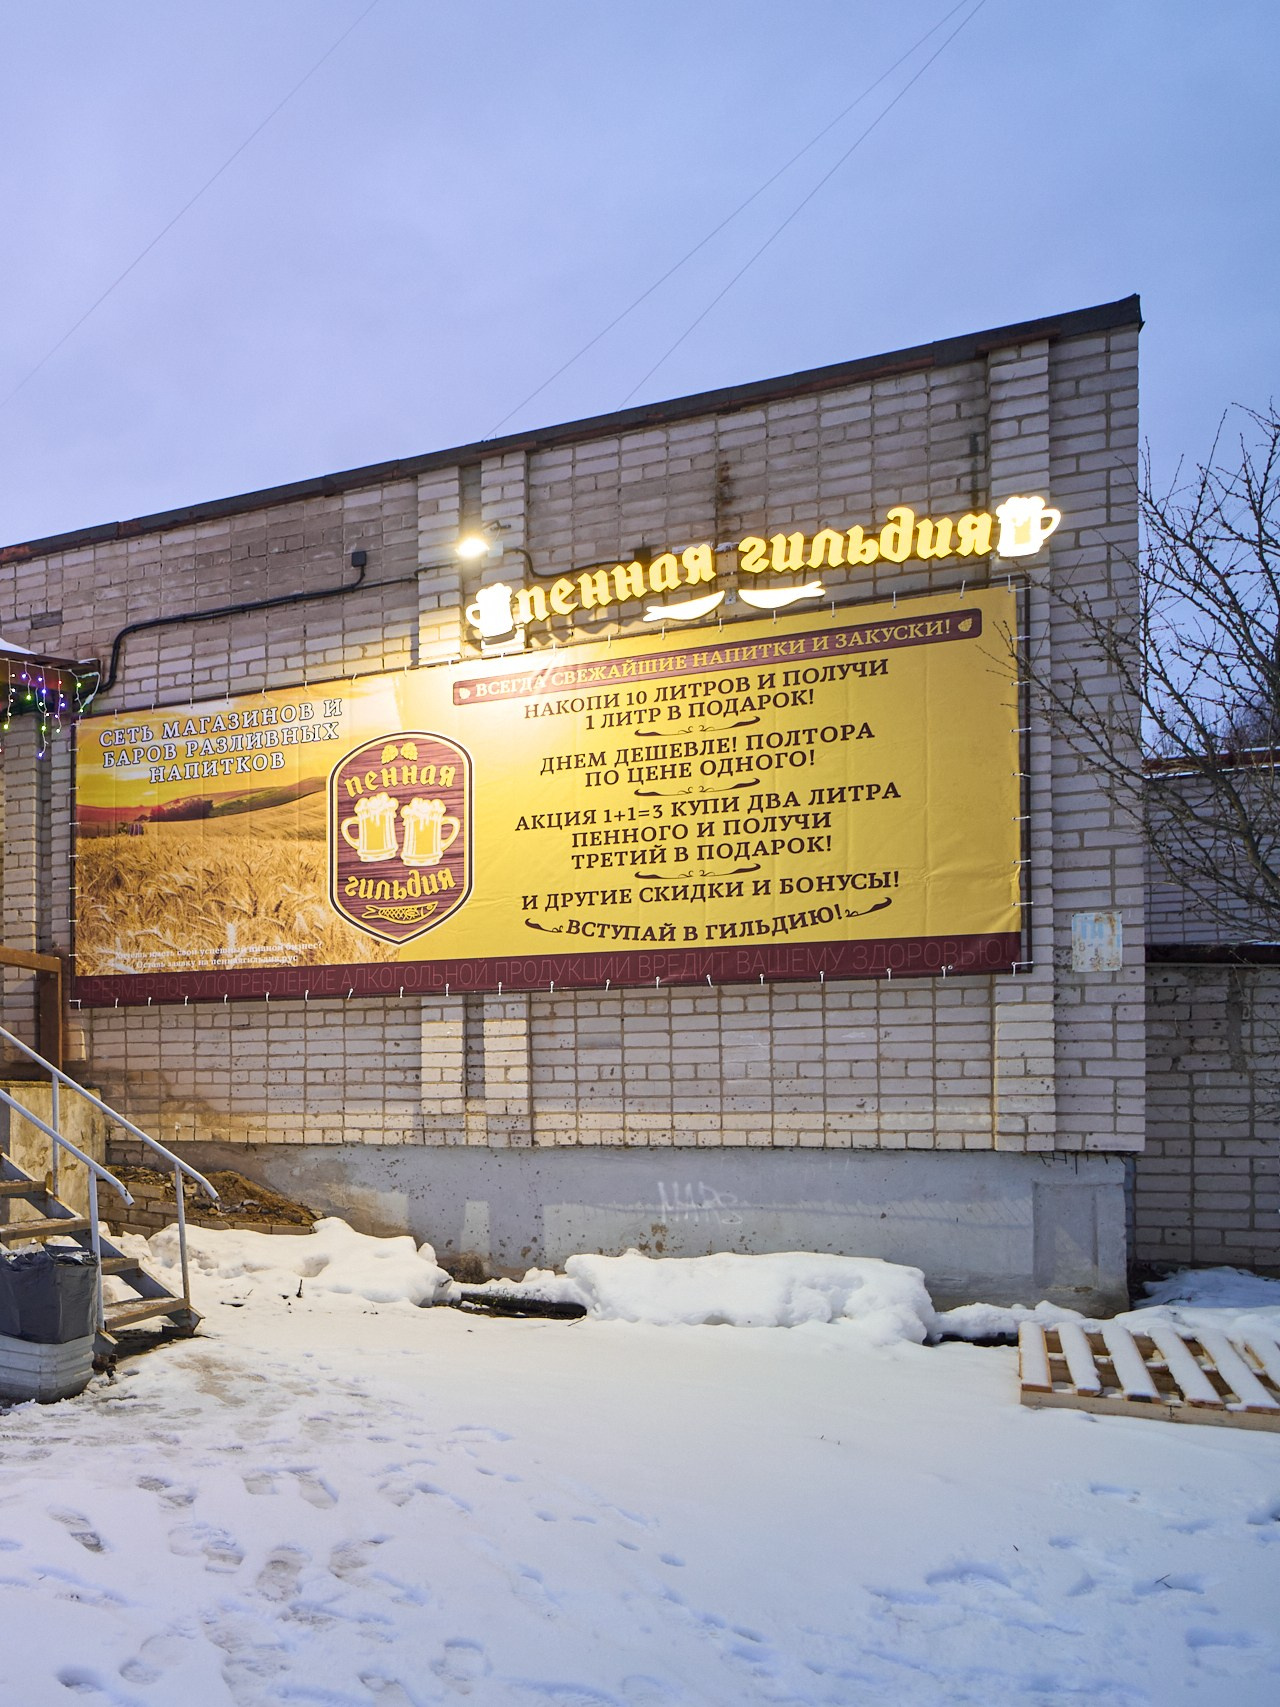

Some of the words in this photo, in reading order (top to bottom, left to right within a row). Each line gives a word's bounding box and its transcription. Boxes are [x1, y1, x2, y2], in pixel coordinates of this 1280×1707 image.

[515, 543, 716, 624] пенная
[738, 507, 993, 574] гильдия
[476, 675, 547, 697] ВСЕГДА
[551, 655, 686, 686] СВЕЖАЙШИЕ
[692, 639, 805, 668] НАПИТКИ
[812, 636, 830, 651] И
[835, 619, 951, 648] ЗАКУСКИ!
[524, 692, 619, 719] НАКОПИ
[626, 690, 647, 706] 10
[653, 677, 750, 703] ЛИТРОВ
[757, 673, 776, 689] И
[782, 658, 889, 686] ПОЛУЧИ
[99, 725, 154, 747] СЕТЬ
[163, 702, 314, 739] МАГАЗИНОВ
[324, 698, 342, 718] И
[586, 716, 594, 730] 1
[600, 703, 661, 728] ЛИТР
[668, 705, 682, 721] В
[689, 689, 814, 719] ПОДАРОК!
[103, 743, 177, 768] БАРОВ
[186, 722, 339, 757] РАЗЛИВНЫХ
[540, 750, 607, 776] ДНЕМ
[614, 735, 738, 767] ДЕШЕВЛЕ!
[746, 722, 875, 751] ПОЛТОРА
[149, 752, 285, 784] НАПИТКОВ
[344, 764, 456, 798] пенная
[585, 769, 619, 787] ПО
[627, 761, 692, 784] ЦЕНЕ
[699, 749, 816, 778] ОДНОГО!
[515, 809, 596, 832] АКЦИЯ
[604, 804, 663, 823] 1+1=3
[670, 796, 740, 817] КУПИ
[747, 790, 800, 814] ДВА
[807, 781, 901, 806] ЛИТРА
[571, 823, 688, 848] ПЕННОГО
[696, 821, 715, 837] И
[723, 811, 832, 836] ПОЛУЧИ
[571, 845, 667, 870] ТРЕТИЙ
[674, 845, 690, 862] В
[697, 835, 832, 861] ПОДАРОК!
[344, 867, 456, 900] гильдия
[521, 894, 538, 911] И
[545, 887, 632, 911] ДРУГИЕ
[639, 881, 744, 904] СКИДКИ
[752, 880, 771, 896] И
[779, 870, 899, 894] БОНУСЫ!
[565, 919, 676, 943] ВСТУПАЙ
[683, 925, 699, 942] В
[705, 904, 842, 941] ГИЛЬДИЮ!
[81, 975, 189, 999] ЧРЕЗМЕРНОЕ
[194, 969, 336, 997] УПОТРЕБЛЕНИЕ
[340, 958, 488, 990] АЛКОГОЛЬНОЙ
[495, 955, 631, 988] ПРОДУКЦИИ
[638, 951, 731, 980] ВРЕДИТ
[736, 946, 845, 974] ВАШЕМУ
[852, 938, 1012, 971] ЗДОРОВЬЮ!
[136, 960, 166, 969] Оставь
[167, 959, 196, 970] заявку
[198, 959, 209, 967] на
[177, 947, 197, 957] свой
